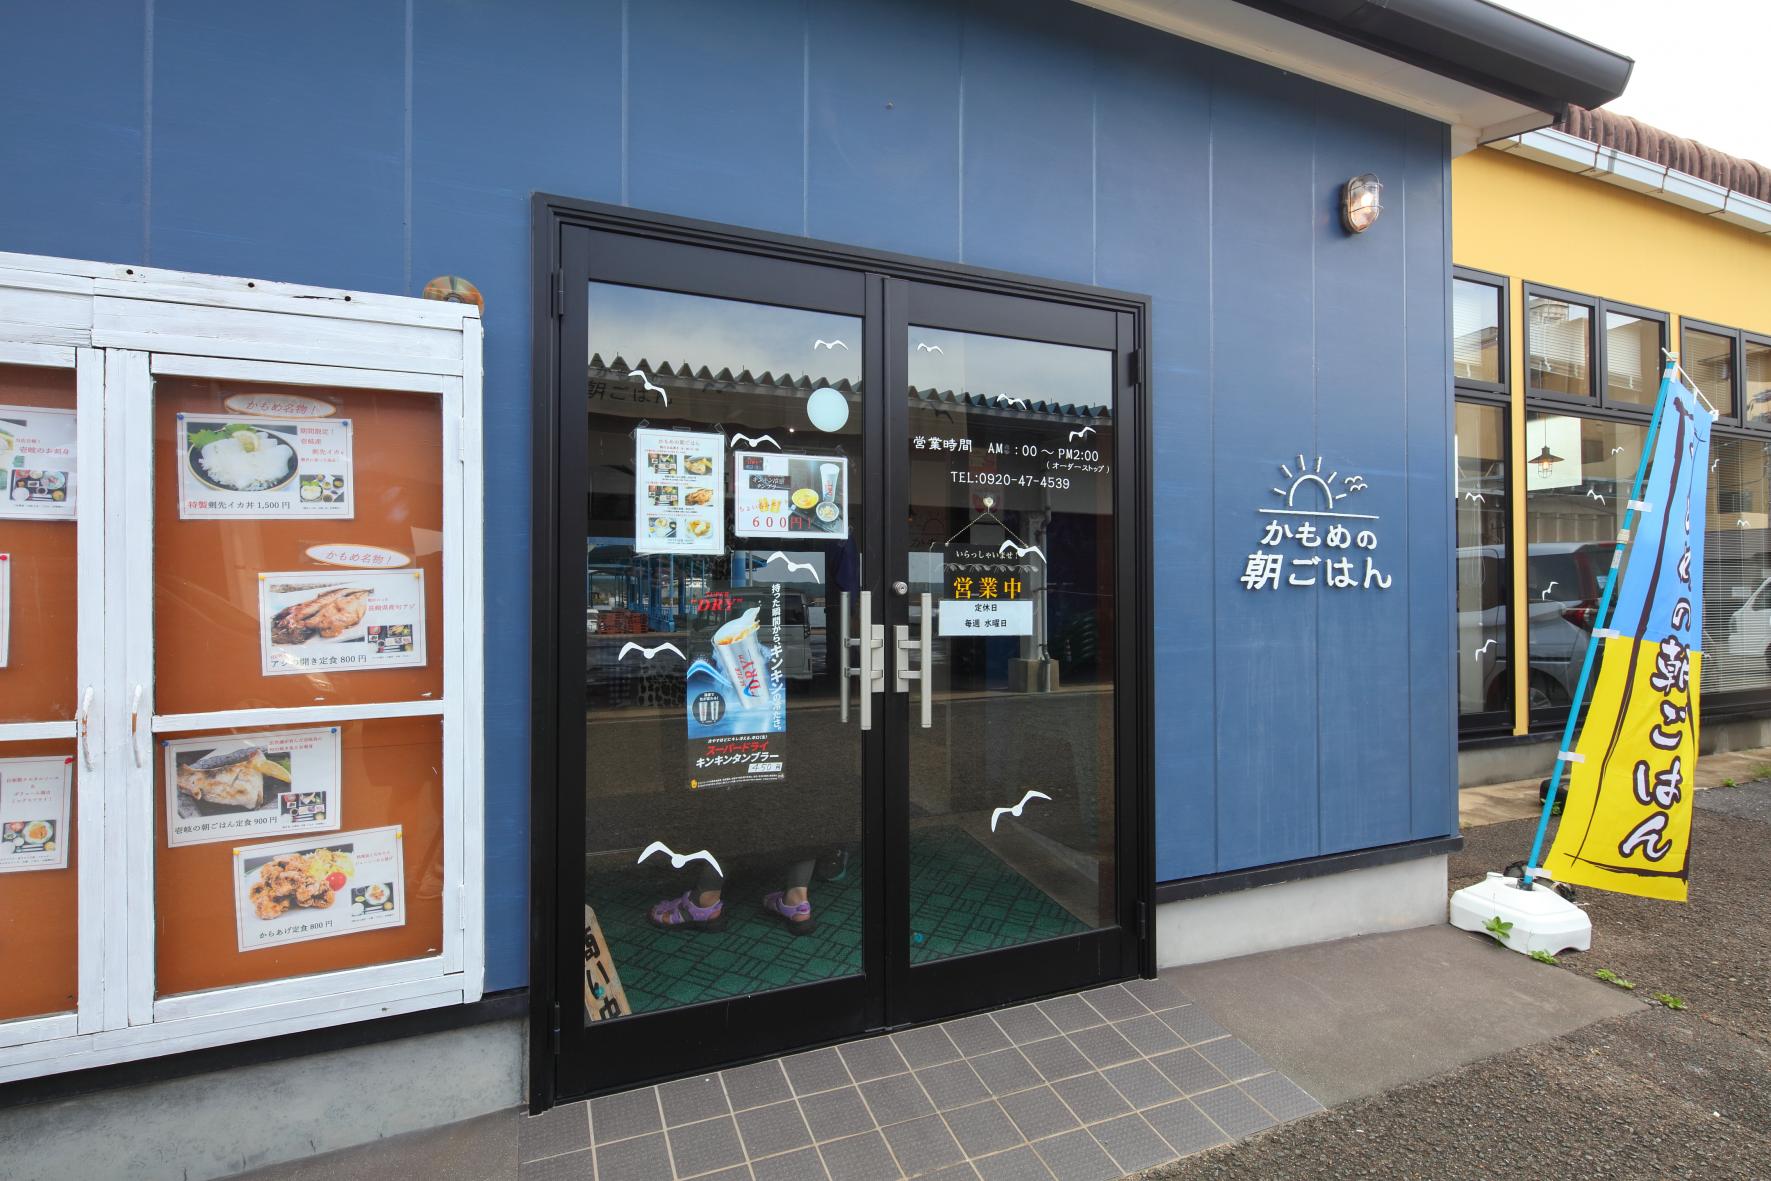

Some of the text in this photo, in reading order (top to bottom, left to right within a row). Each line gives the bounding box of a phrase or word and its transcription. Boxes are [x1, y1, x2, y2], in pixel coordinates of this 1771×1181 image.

[913, 436, 973, 453] 営業時間
[1058, 448, 1100, 462] PM2:00
[950, 471, 1071, 490] TEL:0920-47-4539
[1260, 519, 1378, 550] かもめの
[1240, 550, 1393, 590] 朝ごはん
[953, 576, 1022, 600] 営業中
[974, 603, 998, 612] 定休日
[964, 618, 1008, 628] 毎週 水曜日
[1615, 442, 1692, 862] の朝ごはん
[705, 740, 769, 757] スーパードライ
[695, 751, 780, 769] キンキンタンブラー
[259, 924, 309, 939] からあげ定食
